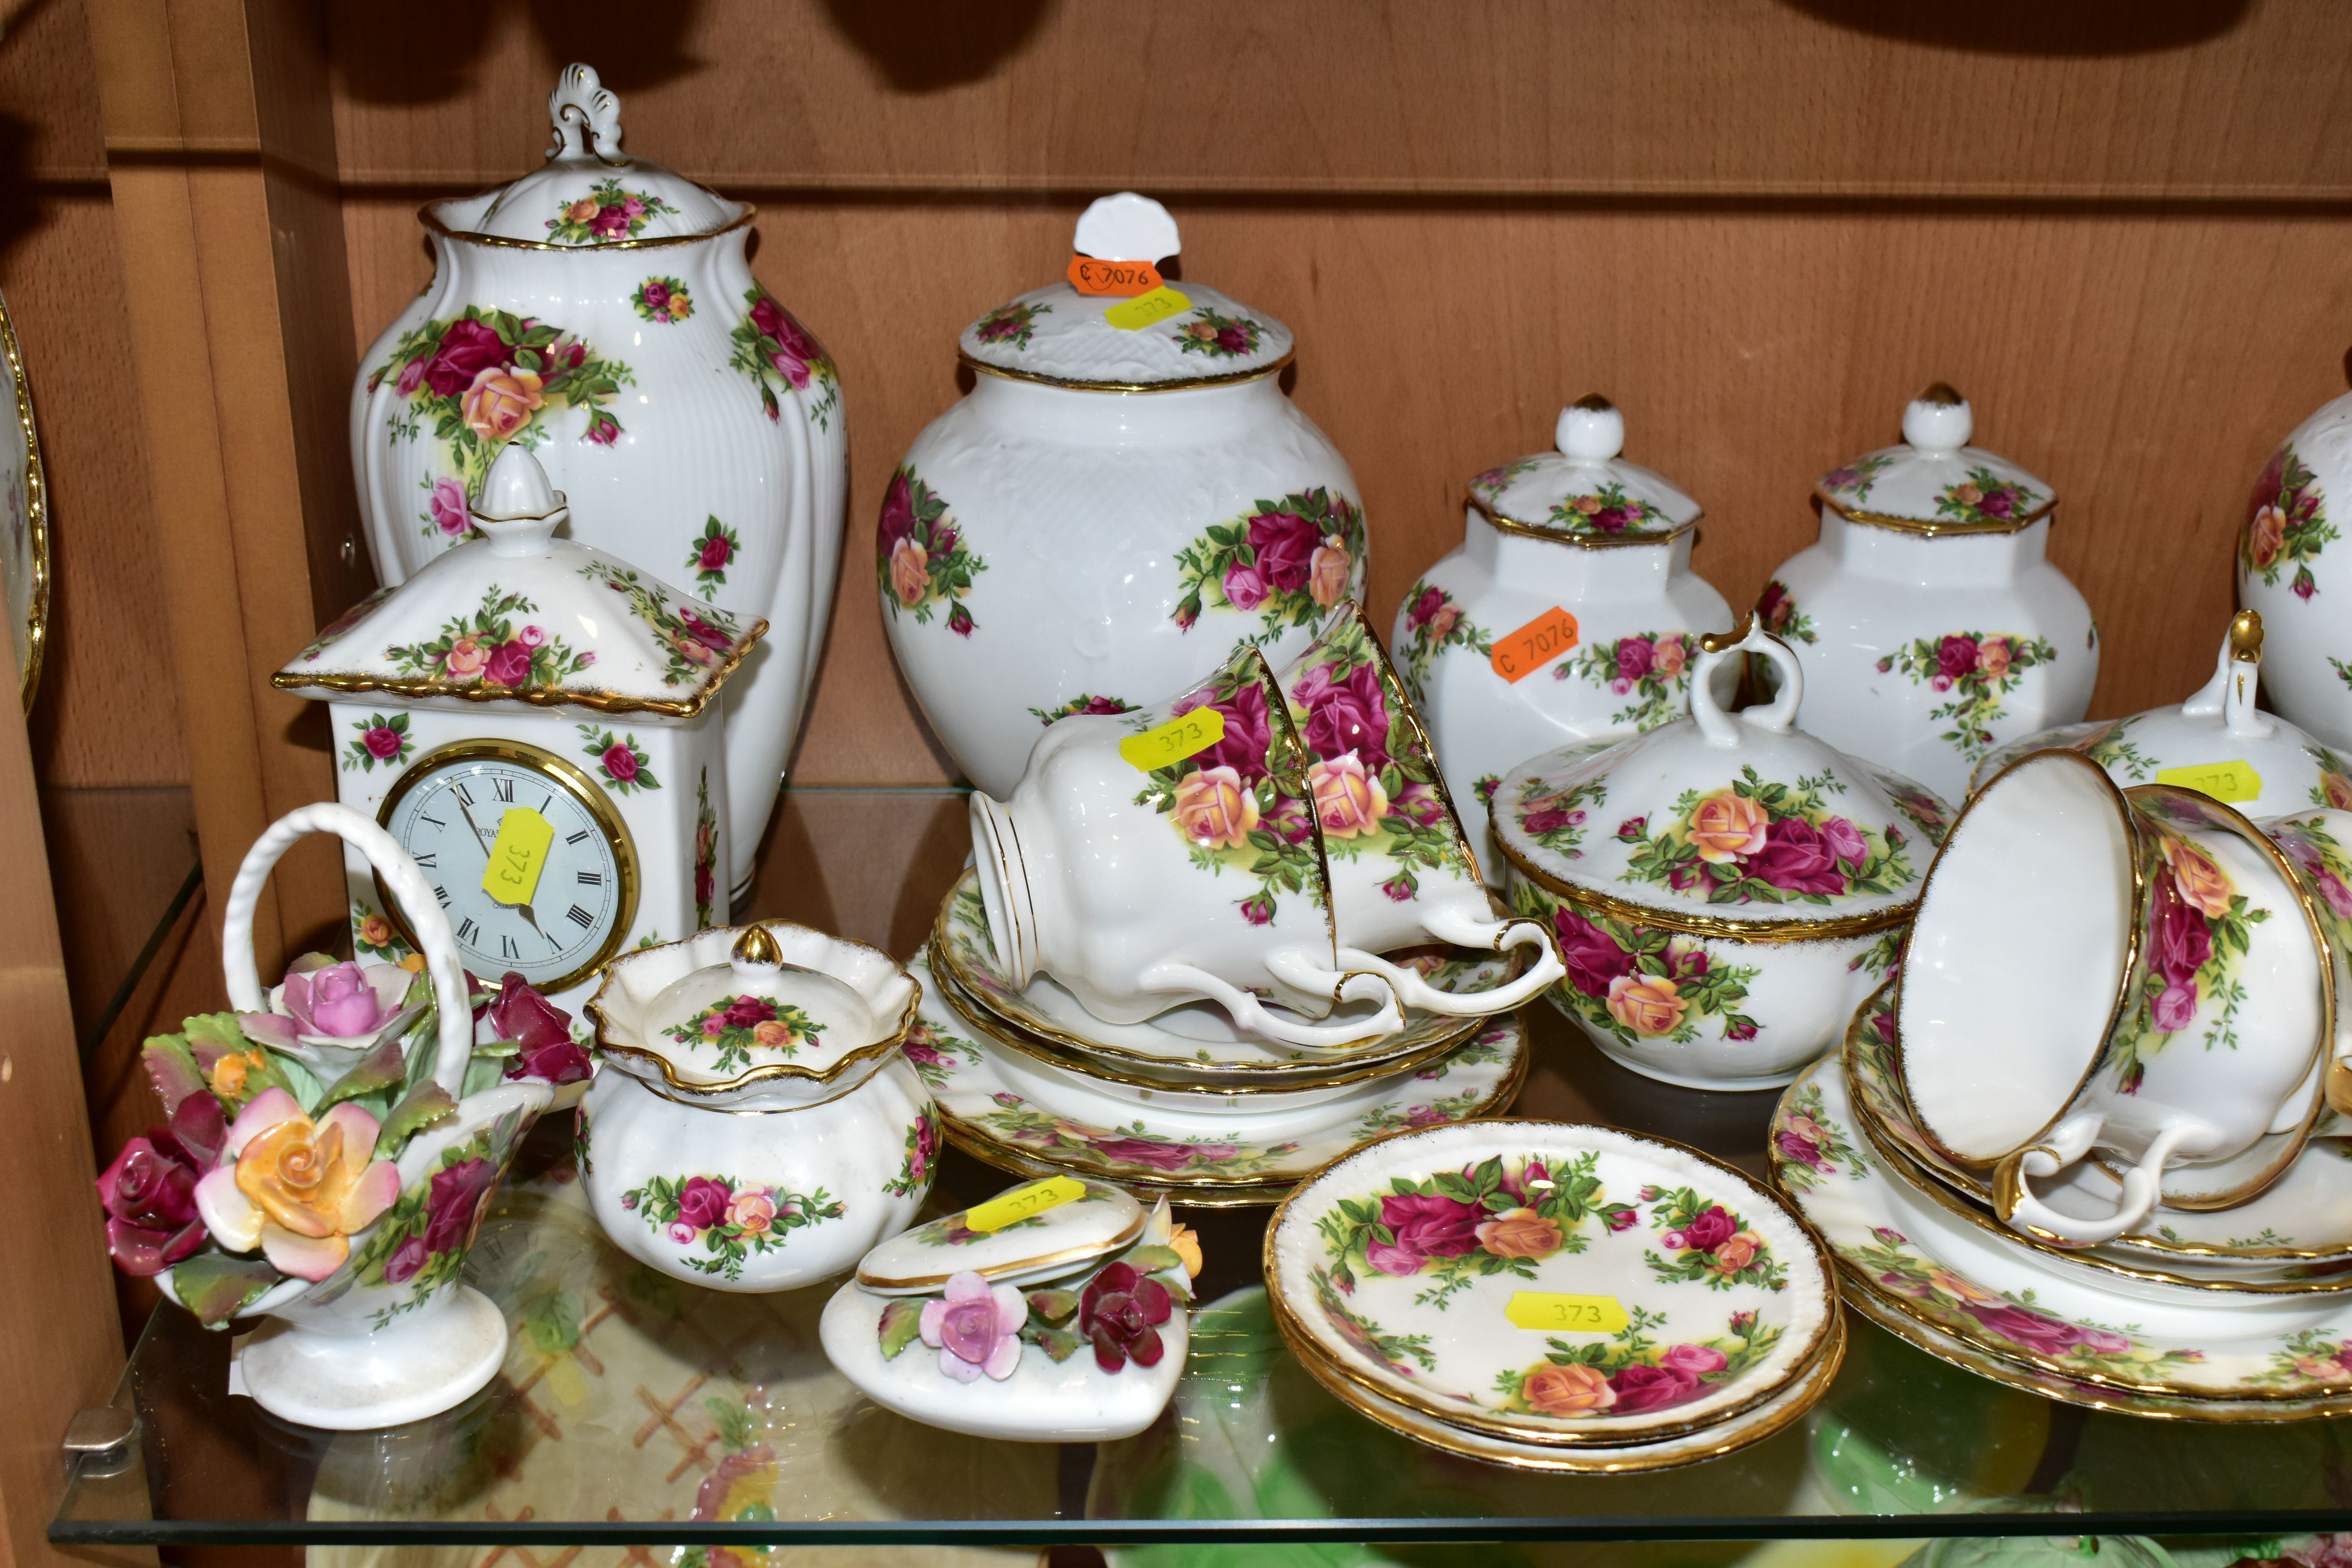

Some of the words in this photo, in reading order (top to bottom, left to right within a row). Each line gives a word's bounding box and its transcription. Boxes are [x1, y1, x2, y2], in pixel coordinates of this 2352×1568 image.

[1102, 267, 1149, 285] 7076
[1499, 654, 1515, 673] C
[1523, 619, 1574, 660] 7076
[1159, 722, 1202, 752] 373
[491, 777, 516, 803] XII
[420, 810, 446, 833] X
[565, 828, 590, 847] II
[500, 845, 530, 885] 373
[577, 870, 602, 887] III
[493, 902, 519, 911] QUART
[565, 903, 595, 931] IIII
[455, 916, 480, 947] VII
[545, 931, 564, 955] V
[501, 935, 521, 959] VI
[1009, 1189, 1058, 1212] 373
[1554, 1304, 1601, 1323] 373
